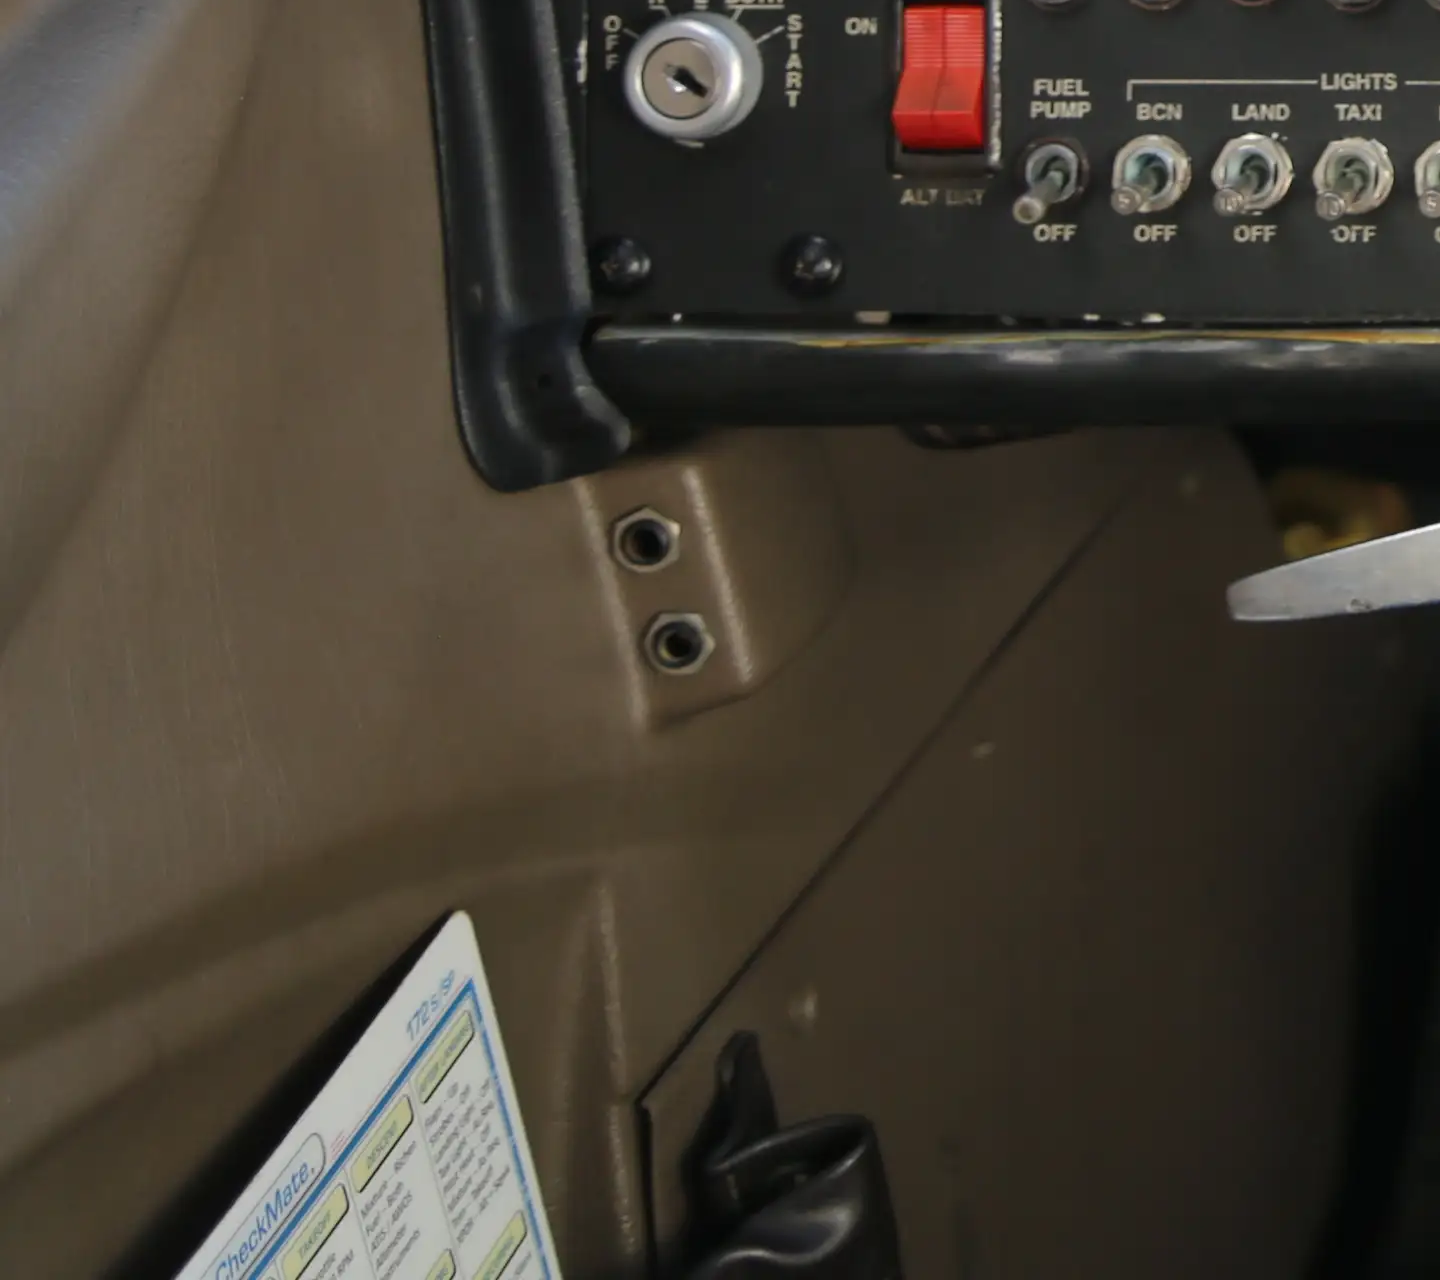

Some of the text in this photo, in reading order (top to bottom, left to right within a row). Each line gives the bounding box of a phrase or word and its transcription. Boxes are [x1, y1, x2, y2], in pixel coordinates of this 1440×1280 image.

[1033, 78, 1090, 97] FUEL
[1320, 72, 1398, 91] LIGHTS
[1030, 100, 1092, 119] PUMP
[1136, 102, 1183, 121] BCN
[1334, 103, 1382, 121] TAXI
